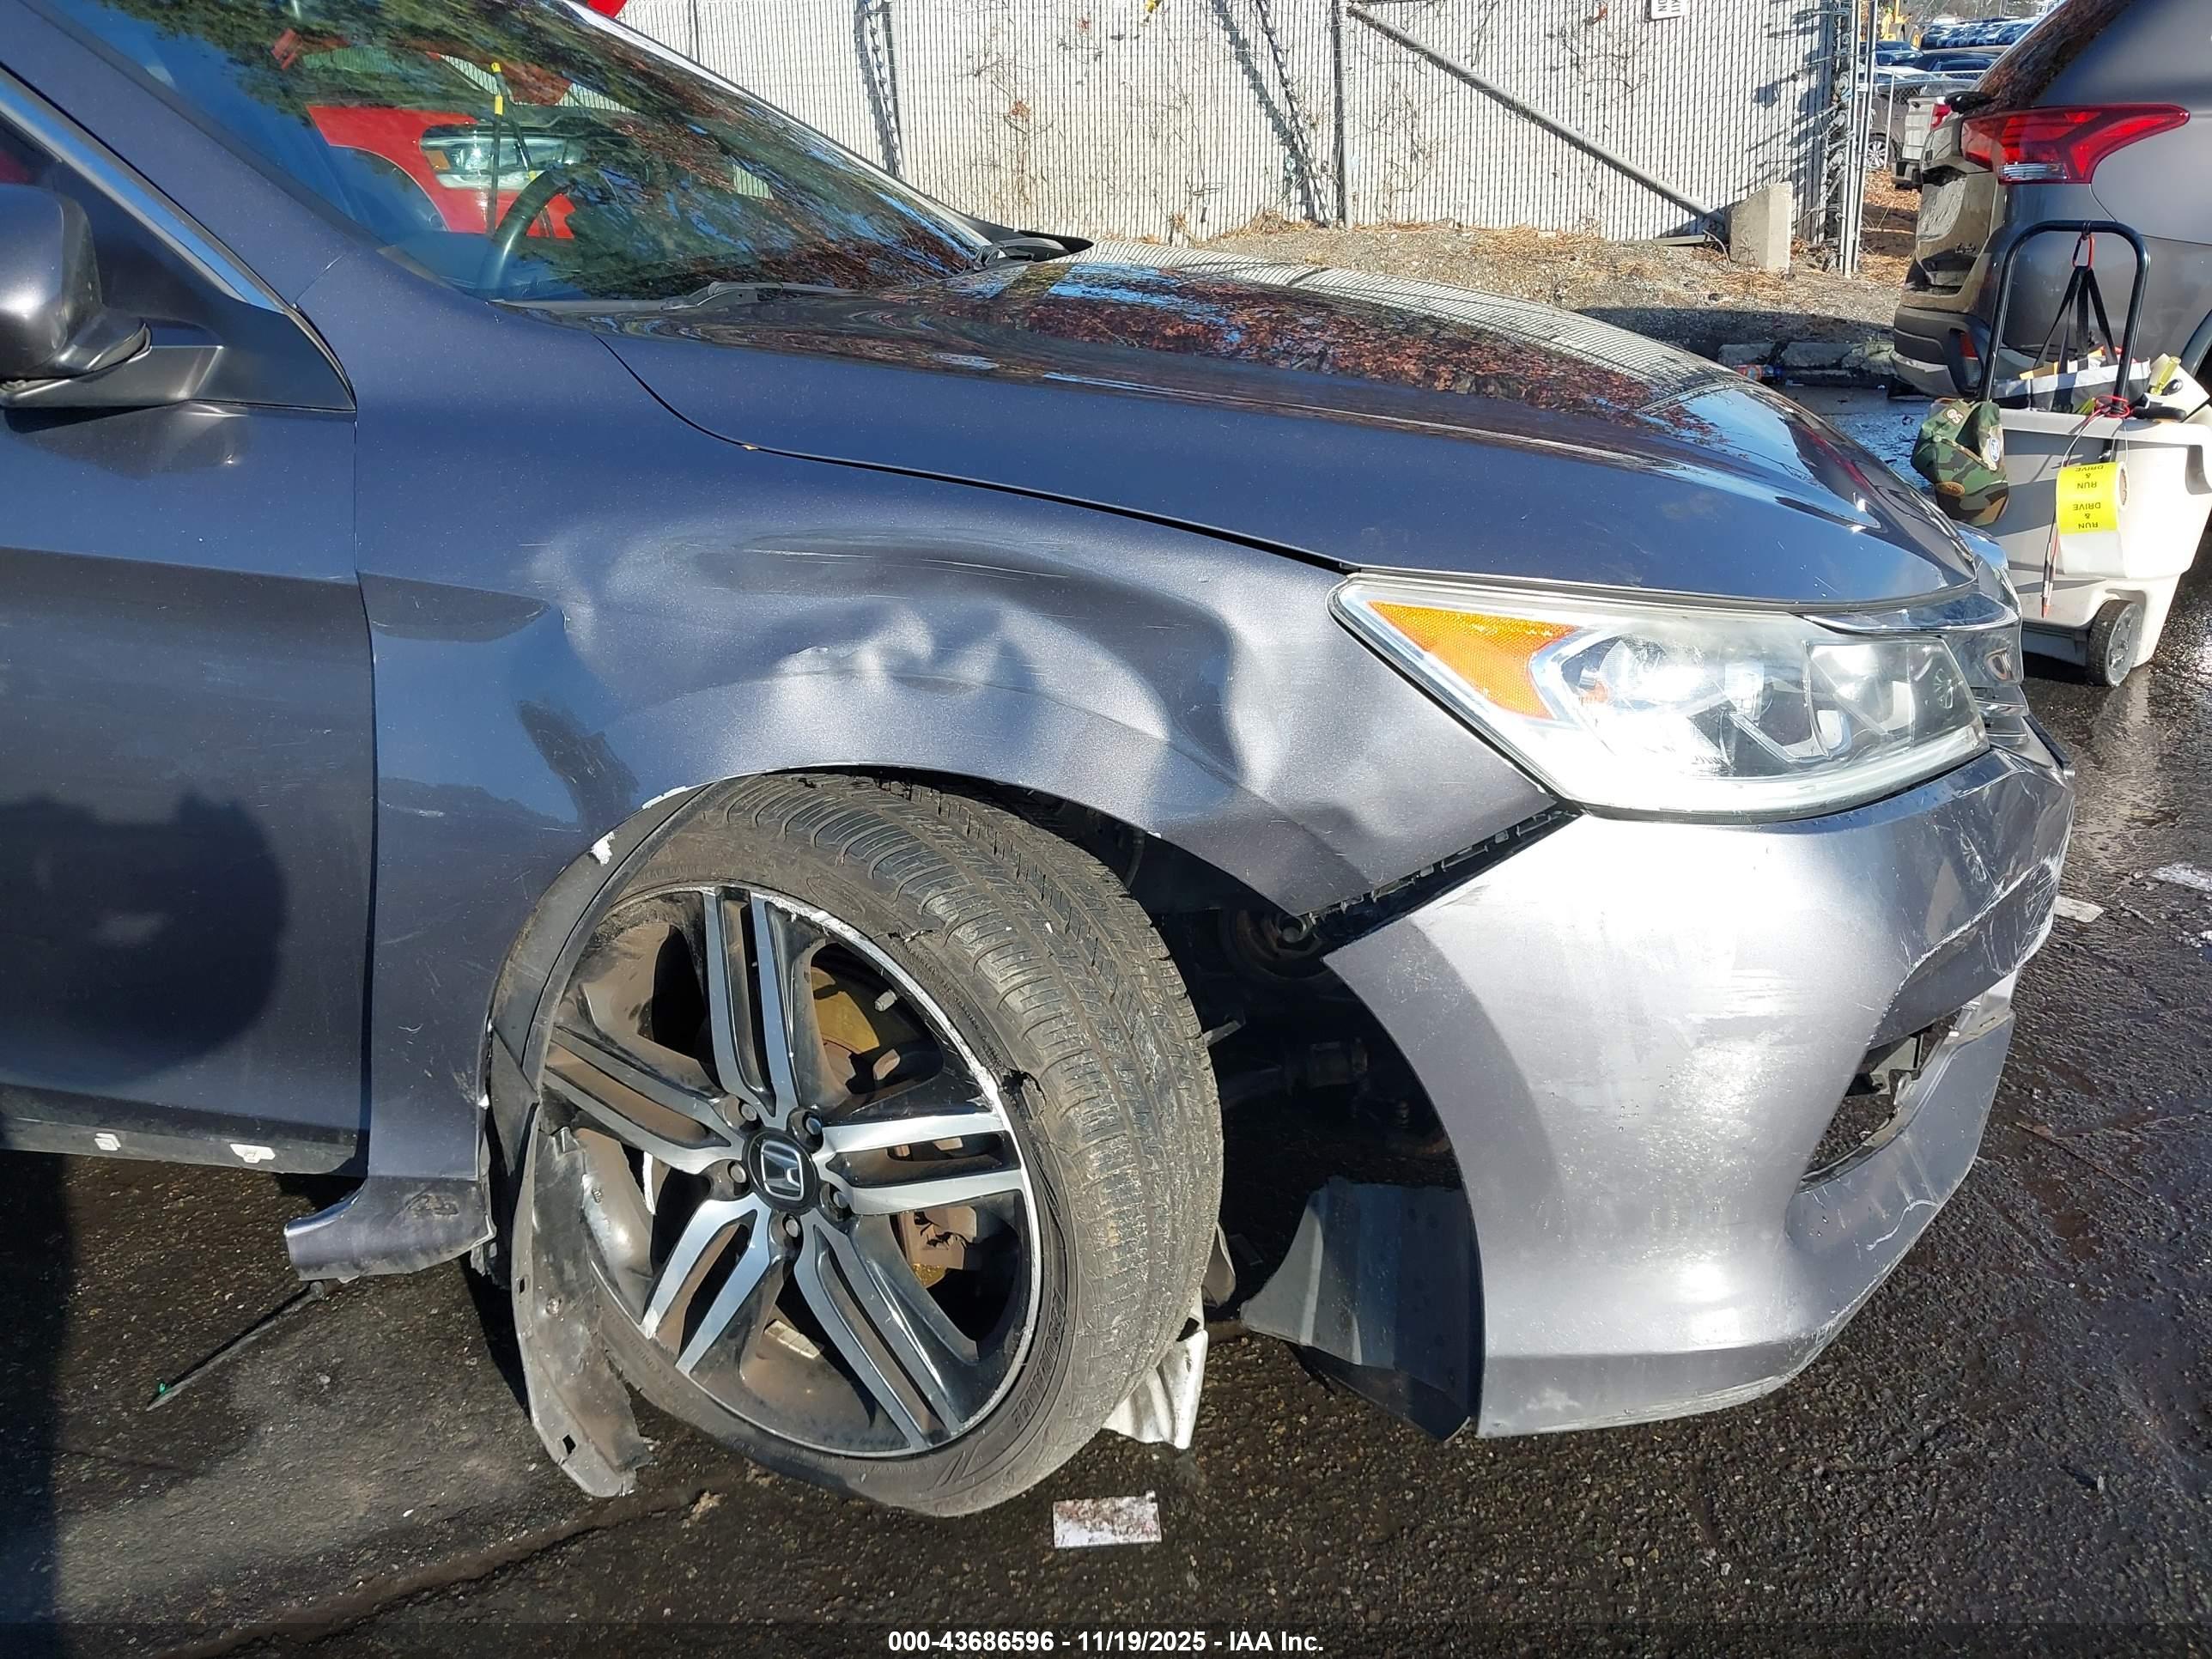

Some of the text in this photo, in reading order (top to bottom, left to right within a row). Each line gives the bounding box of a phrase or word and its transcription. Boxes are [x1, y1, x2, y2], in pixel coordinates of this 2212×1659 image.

[2076, 481, 2097, 489] RUN
[2072, 501, 2101, 511] DRIVE
[2078, 521, 2099, 530] RUN
